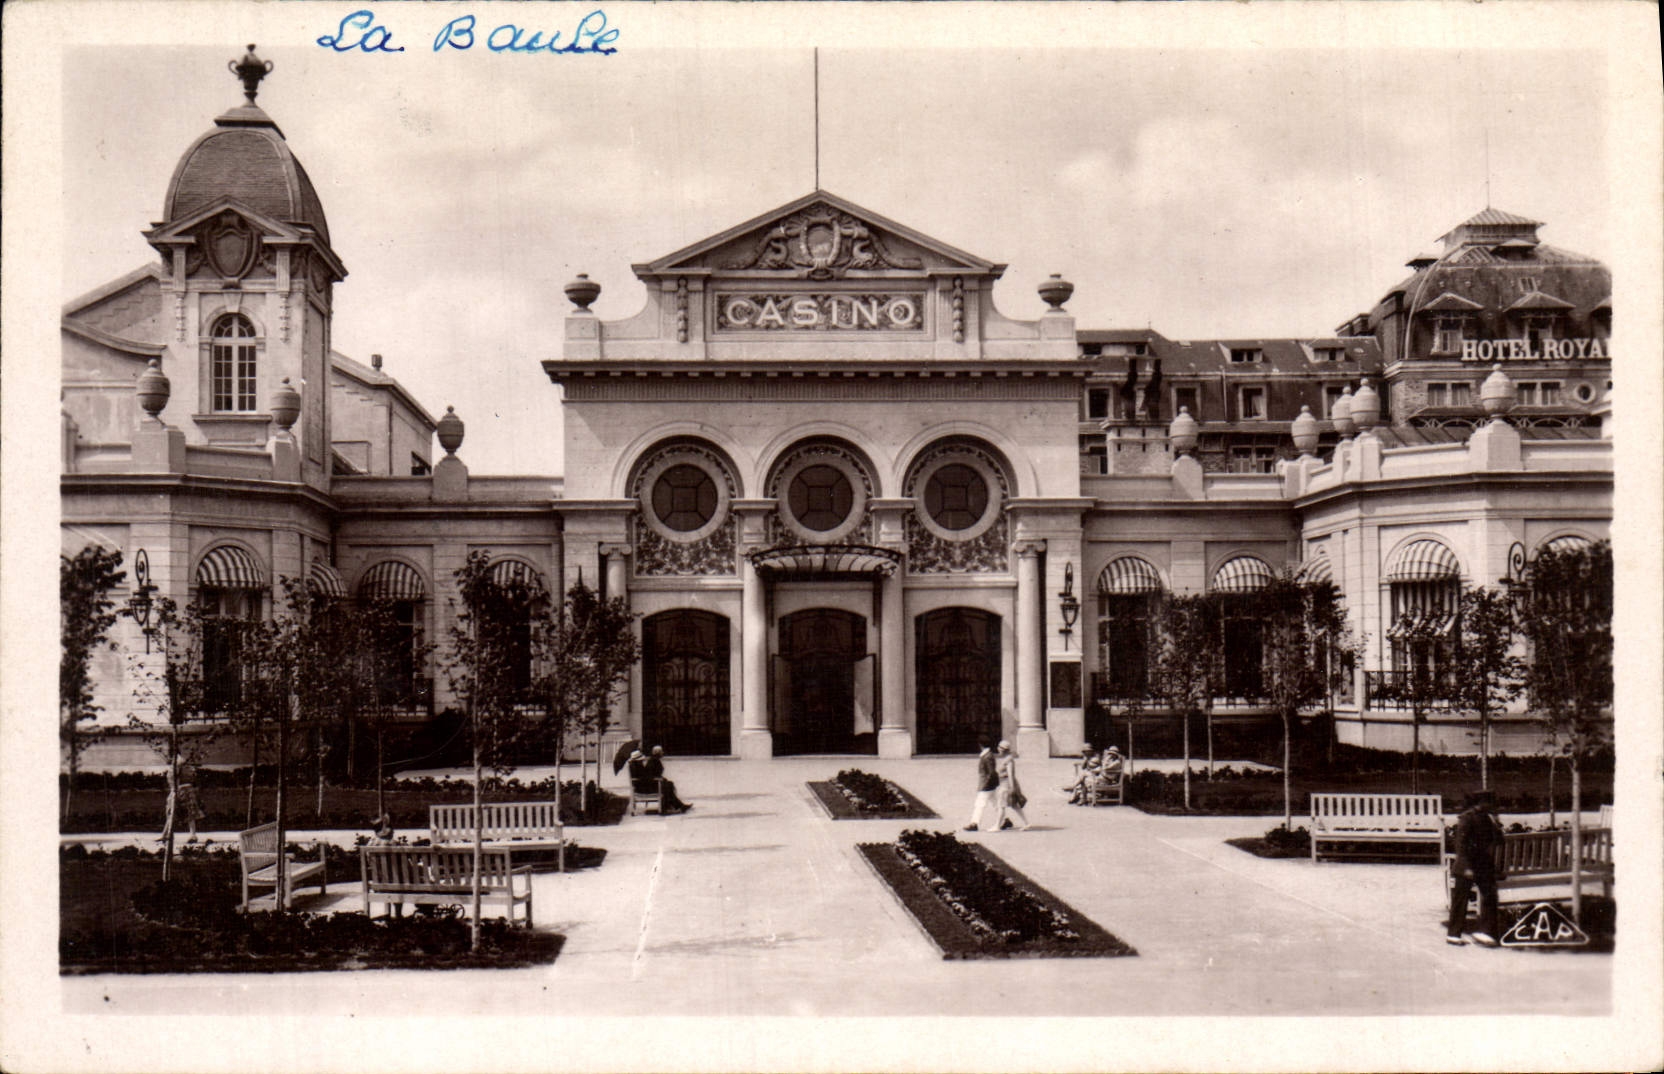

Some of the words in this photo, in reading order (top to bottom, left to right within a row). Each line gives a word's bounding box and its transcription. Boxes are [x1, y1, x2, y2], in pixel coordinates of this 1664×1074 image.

[316, 10, 405, 51] La
[726, 299, 916, 326] CASINO
[1461, 338, 1540, 361] HOTEL
